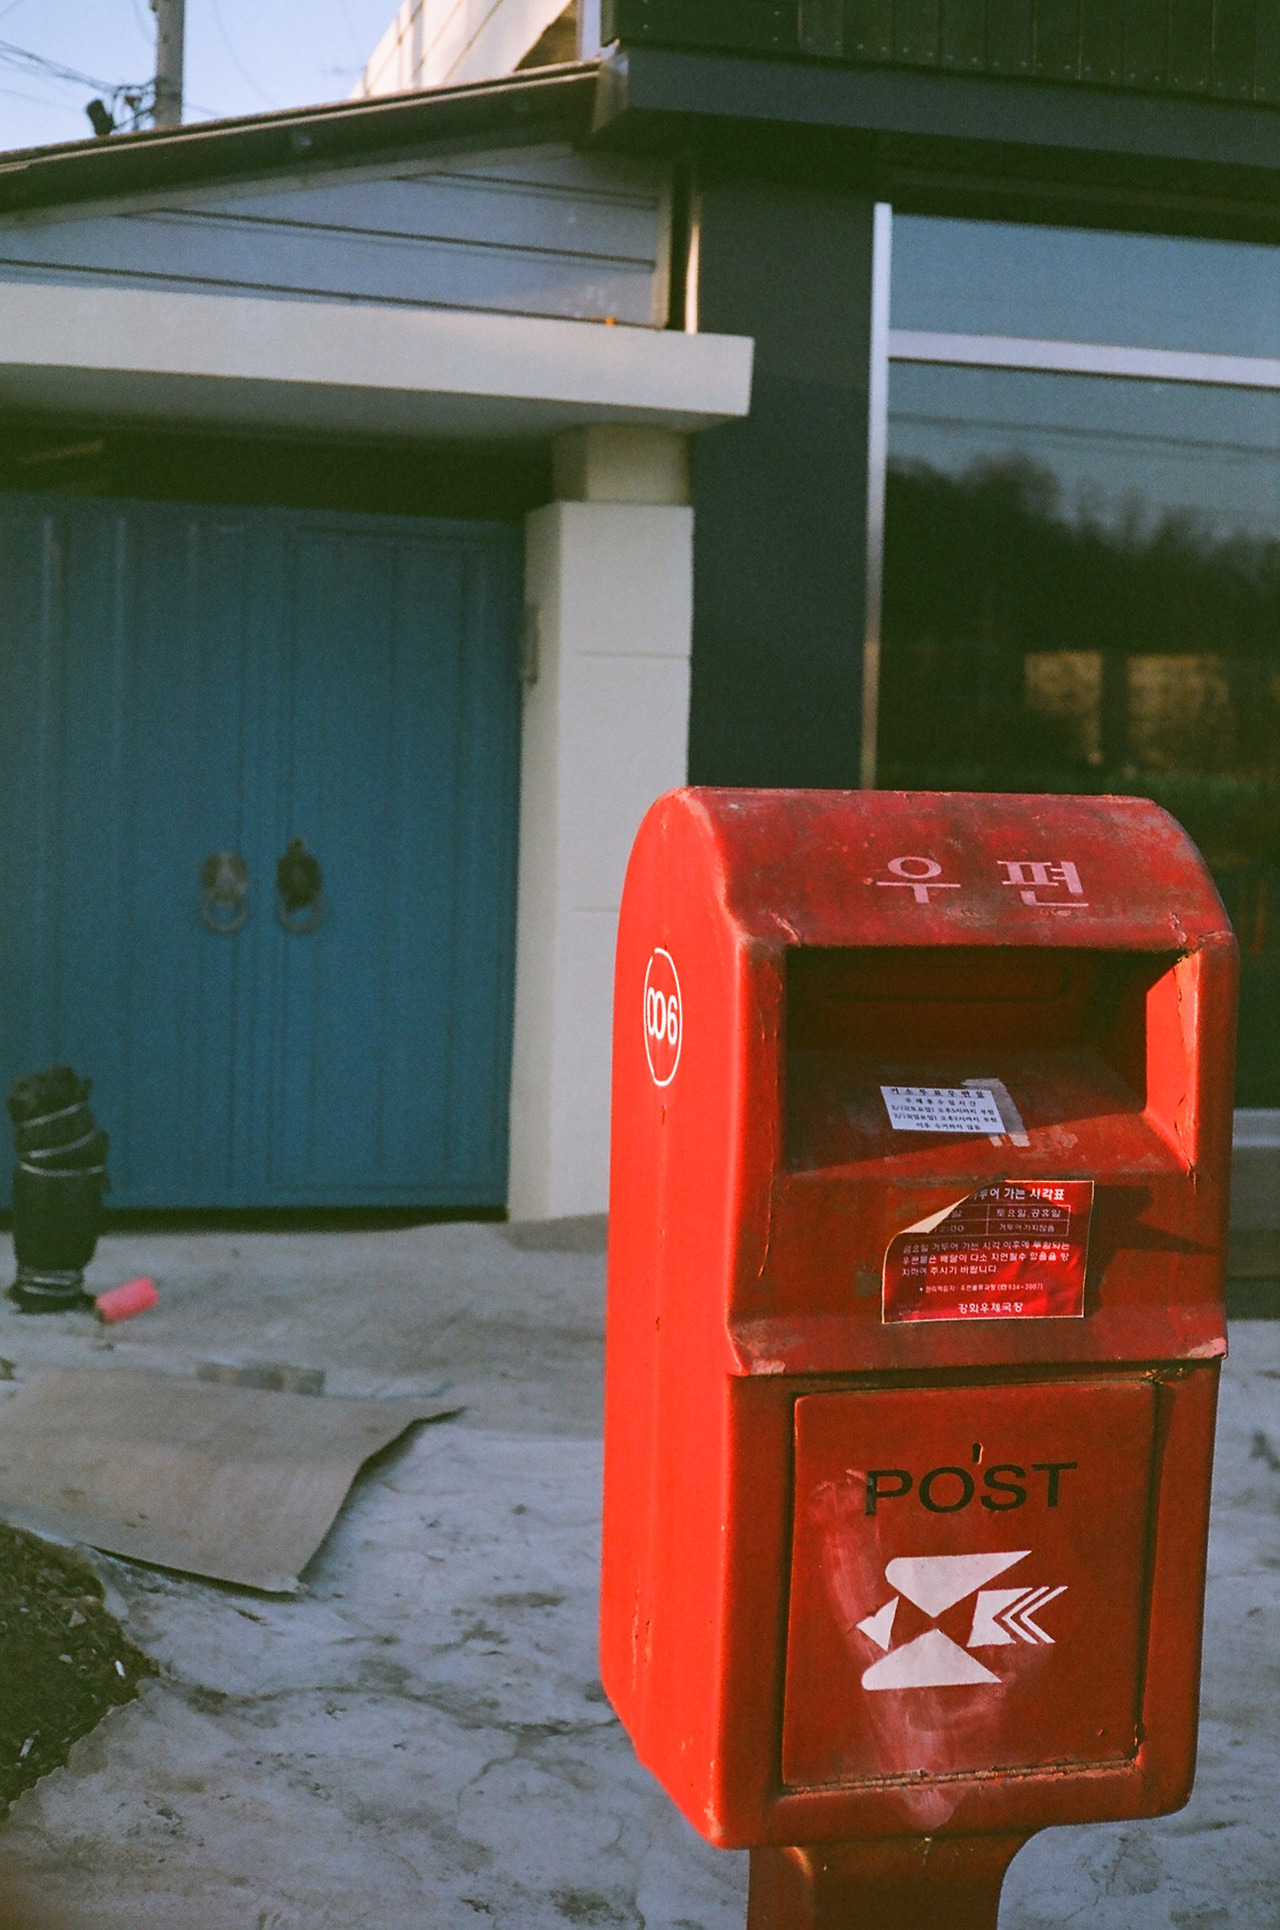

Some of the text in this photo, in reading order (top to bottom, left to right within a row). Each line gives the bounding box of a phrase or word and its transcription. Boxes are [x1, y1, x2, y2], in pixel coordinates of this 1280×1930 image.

[647, 986, 678, 1045] 006
[1004, 1187, 1026, 1200] 가는
[1030, 1187, 1065, 1201] 시각표
[962, 1241, 979, 1250] 가는
[983, 1241, 1000, 1250] 시각
[1003, 1240, 1030, 1249] 이후에
[940, 1253, 967, 1263] 배달이
[970, 1252, 988, 1263] 다소
[1029, 1251, 1057, 1261] 있음을
[930, 1265, 957, 1275] 주시기
[960, 1265, 999, 1275] 바랍니다.
[958, 1302, 1024, 1314] 강화우체국장
[865, 1462, 1078, 1516] POST
